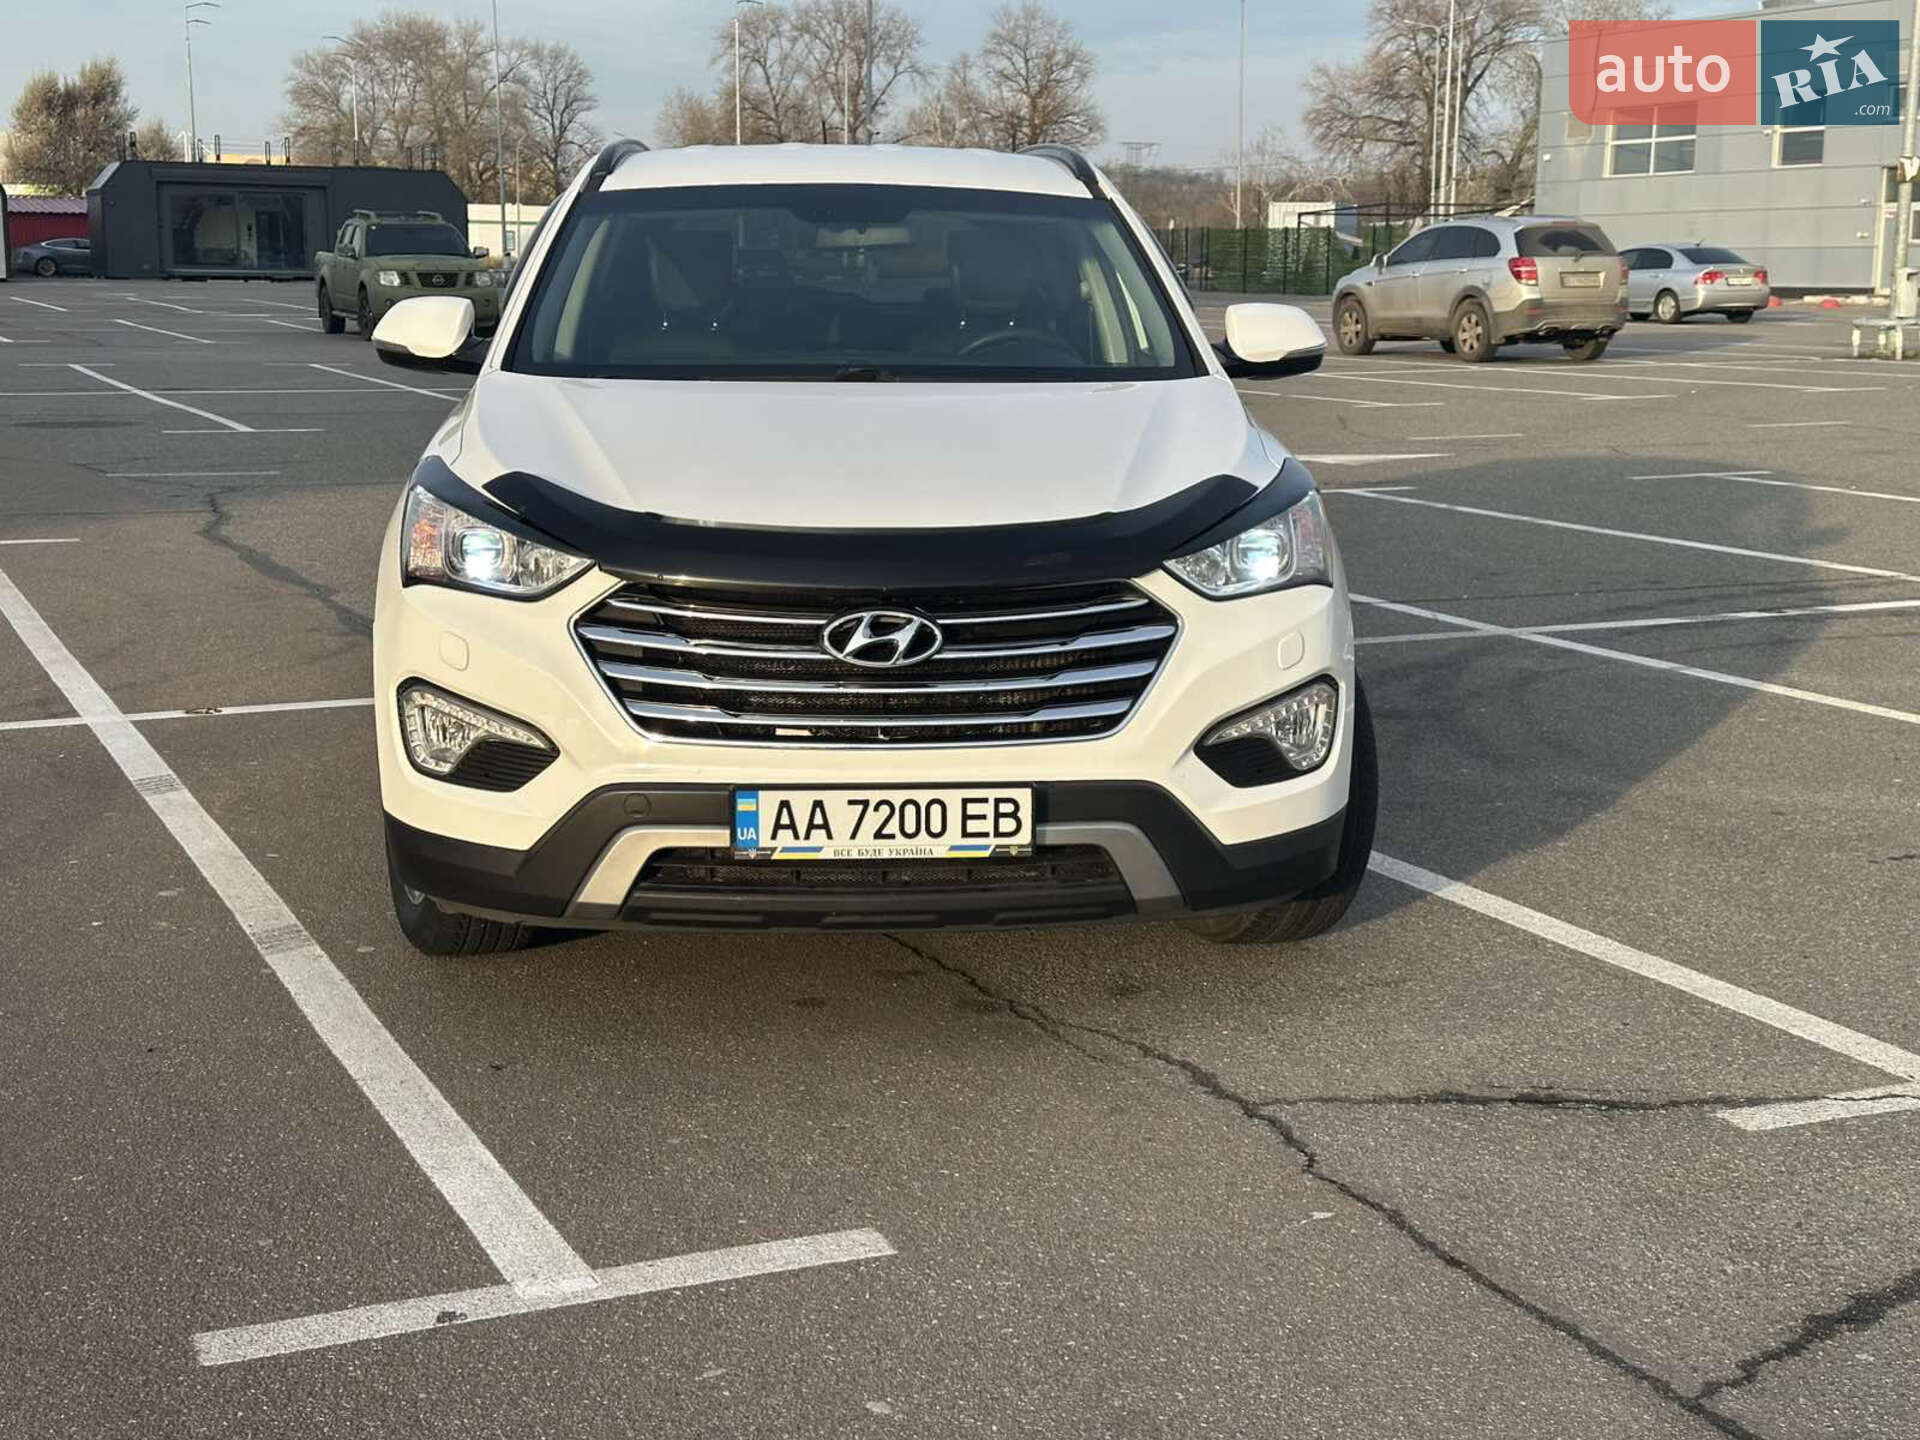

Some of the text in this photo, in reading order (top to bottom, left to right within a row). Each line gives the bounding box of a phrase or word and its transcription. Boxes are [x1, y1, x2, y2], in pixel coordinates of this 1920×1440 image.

[770, 797, 1022, 840] AA 7200 EB
[737, 828, 757, 840] UA
